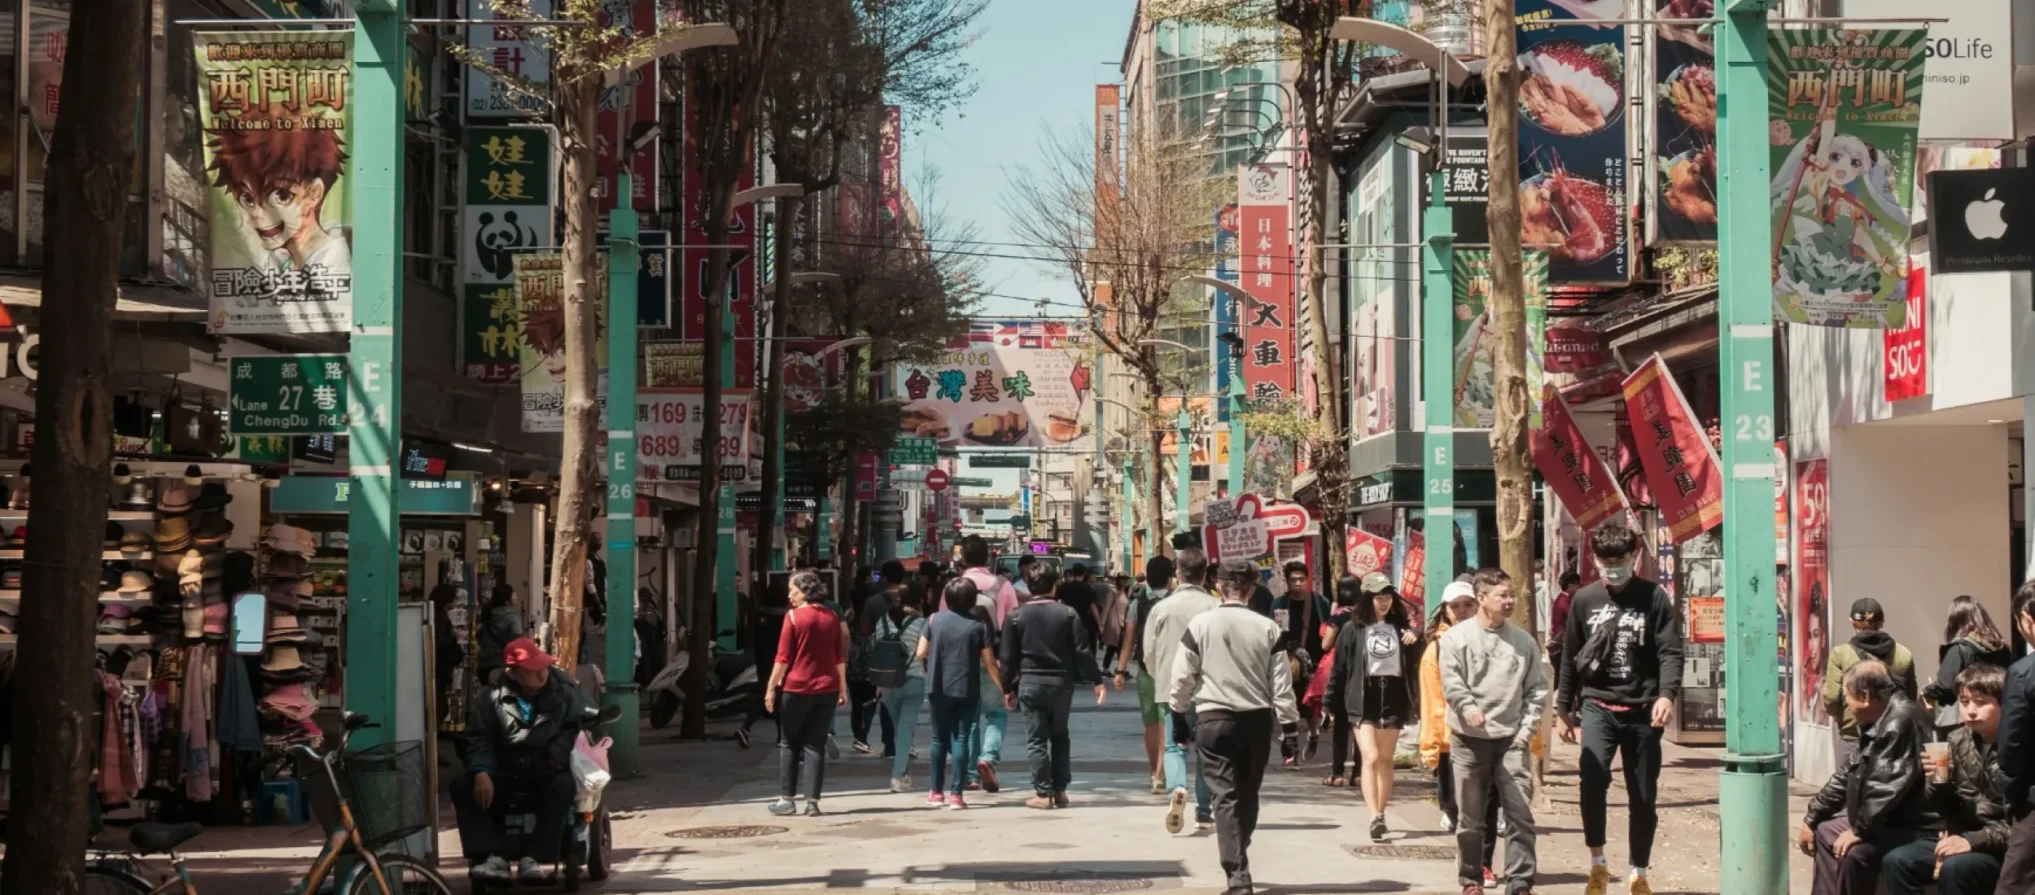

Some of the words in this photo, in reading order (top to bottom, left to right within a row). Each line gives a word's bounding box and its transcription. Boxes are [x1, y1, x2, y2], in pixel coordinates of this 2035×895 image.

[206, 65, 350, 113] 西門町
[1787, 67, 1910, 107] 西門町
[211, 116, 271, 130] Welcome
[276, 116, 293, 130] to
[301, 115, 344, 130] Ximen
[480, 135, 534, 200] 娃娃
[1257, 218, 1272, 288] 日本料理
[1945, 255, 1992, 265] Premium
[1993, 253, 2032, 264] Reseller
[1251, 302, 1283, 399] 大車輪
[236, 362, 343, 380] 成都路
[362, 362, 380, 392] E
[467, 364, 521, 379] 請上2
[1743, 360, 1762, 391] E
[905, 368, 1035, 403] 台灣美味
[239, 397, 268, 411] Lane
[279, 386, 303, 411] 27
[313, 385, 337, 411] 巷
[244, 414, 309, 429] ChengDu
[318, 414, 341, 427] Rd.
[350, 402, 389, 428] 24
[652, 402, 687, 424] 169
[1735, 414, 1773, 442] 23
[641, 435, 681, 457] 689
[1434, 447, 1446, 466] E
[614, 452, 626, 471] E
[609, 483, 633, 500] 26
[1430, 478, 1453, 495] 25
